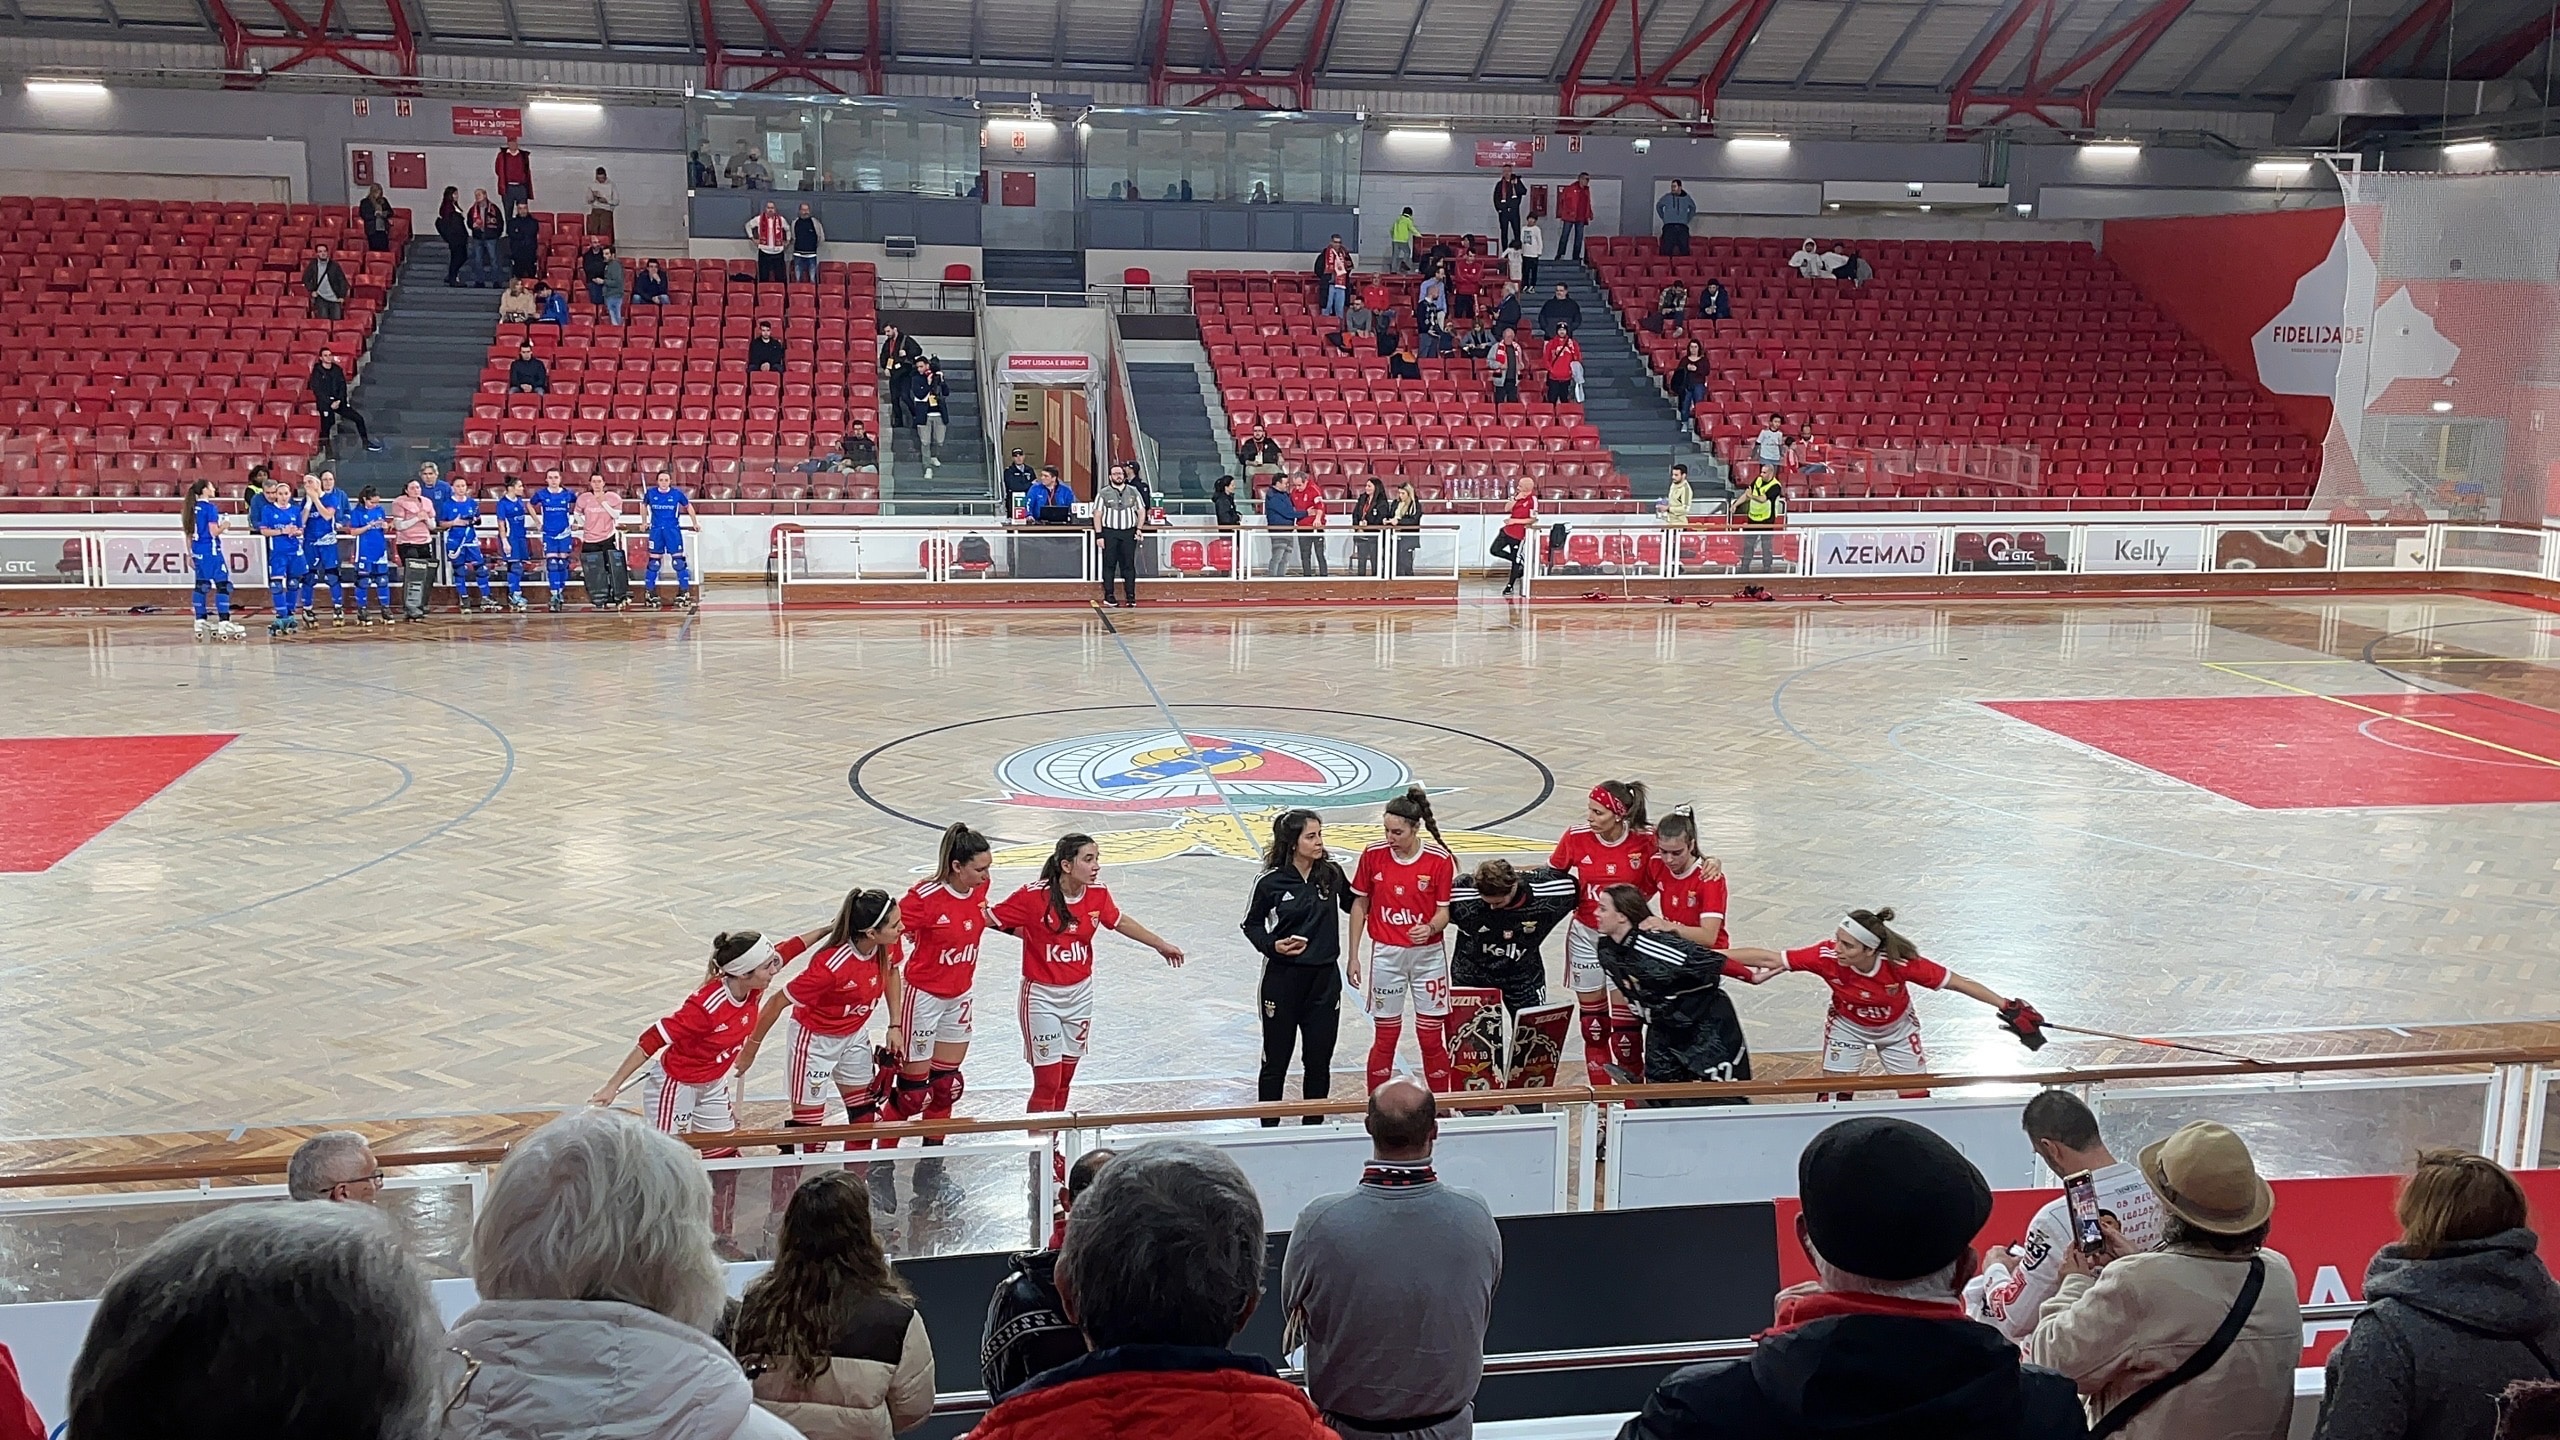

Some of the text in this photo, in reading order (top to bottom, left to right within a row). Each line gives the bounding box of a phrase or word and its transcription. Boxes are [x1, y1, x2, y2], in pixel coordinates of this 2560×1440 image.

[1015, 510, 1022, 519] F
[1080, 506, 1086, 516] 5
[1154, 509, 1162, 517] F
[1828, 546, 1925, 564] AZEMAD
[2012, 551, 2035, 561] GTC
[2115, 539, 2170, 566] Kelly
[6, 560, 36, 572] GTC
[122, 552, 248, 574] AZED
[1381, 906, 1424, 926] Kelly
[939, 943, 978, 966] Kelly
[1046, 941, 1088, 966] Kelly
[1482, 943, 1527, 962] Kelly
[1373, 987, 1404, 996] AZEMAD
[1426, 976, 1446, 1001] 95
[1463, 1051, 1479, 1060] MV
